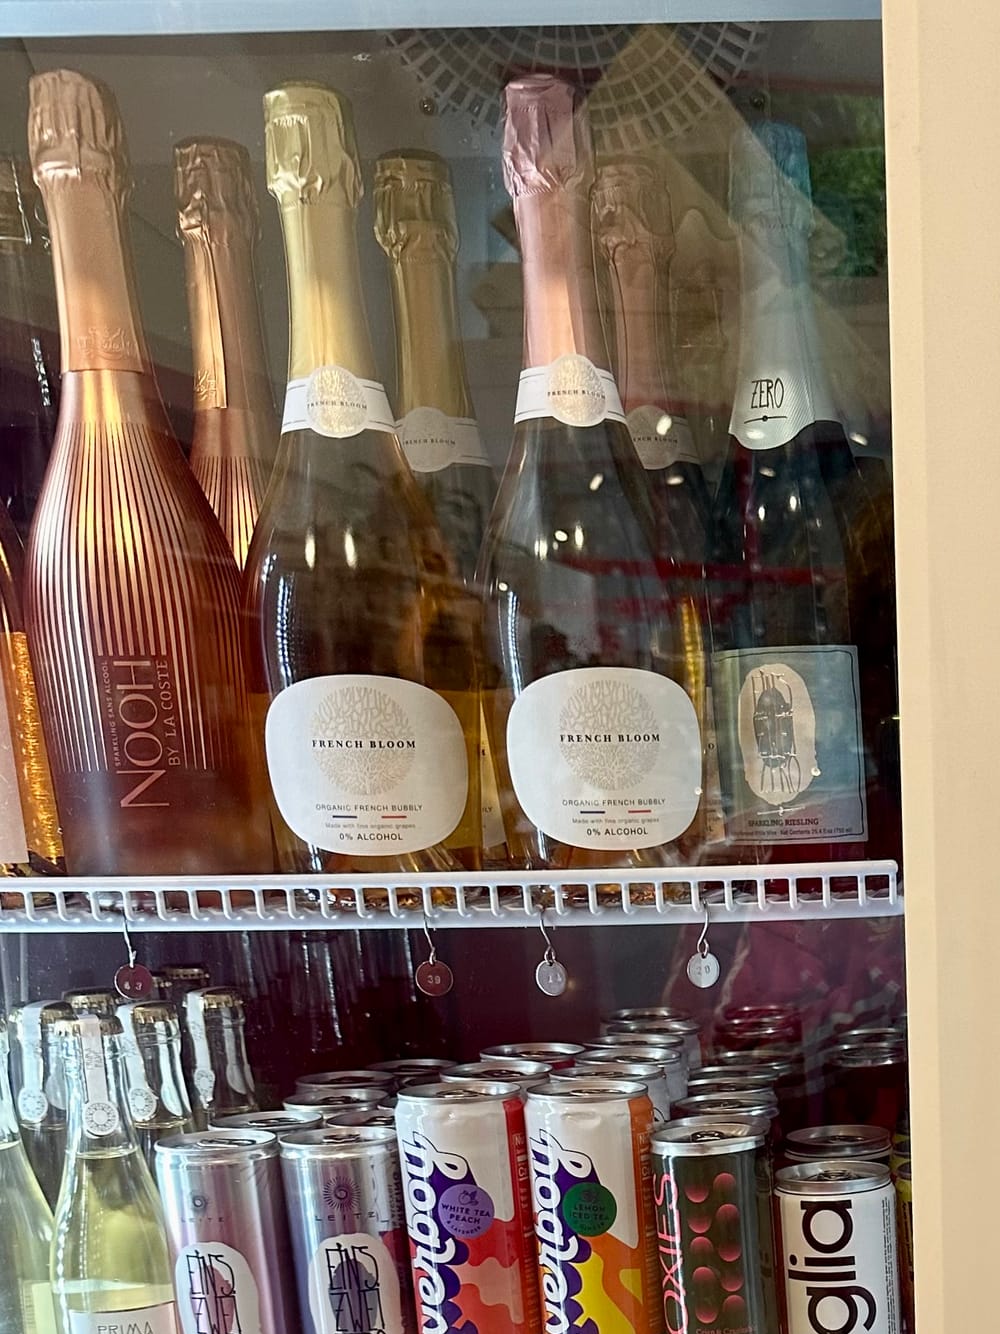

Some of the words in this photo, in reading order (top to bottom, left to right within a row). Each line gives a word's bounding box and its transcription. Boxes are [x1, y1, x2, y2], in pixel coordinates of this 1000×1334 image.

[751, 378, 784, 408] ZERO
[156, 660, 173, 710] COSTE
[113, 660, 170, 808] NOOH
[163, 716, 177, 737] LA
[312, 739, 363, 749] FRENCH
[369, 739, 416, 749] BLOOM
[560, 734, 612, 742] FRENCH
[618, 734, 660, 742] BLOOM
[167, 747, 181, 766] BY
[315, 803, 352, 811] ORGANIC
[354, 804, 389, 812] FRENCH
[391, 804, 423, 812] BUBBLY
[339, 833, 353, 841] 0%
[357, 832, 404, 841] ALCOHOL
[586, 828, 601, 836] 0%
[604, 828, 649, 836] ALCOHOL
[441, 1202, 471, 1217] WHITE
[473, 1207, 491, 1219] TEA
[449, 1213, 481, 1226] PEACH
